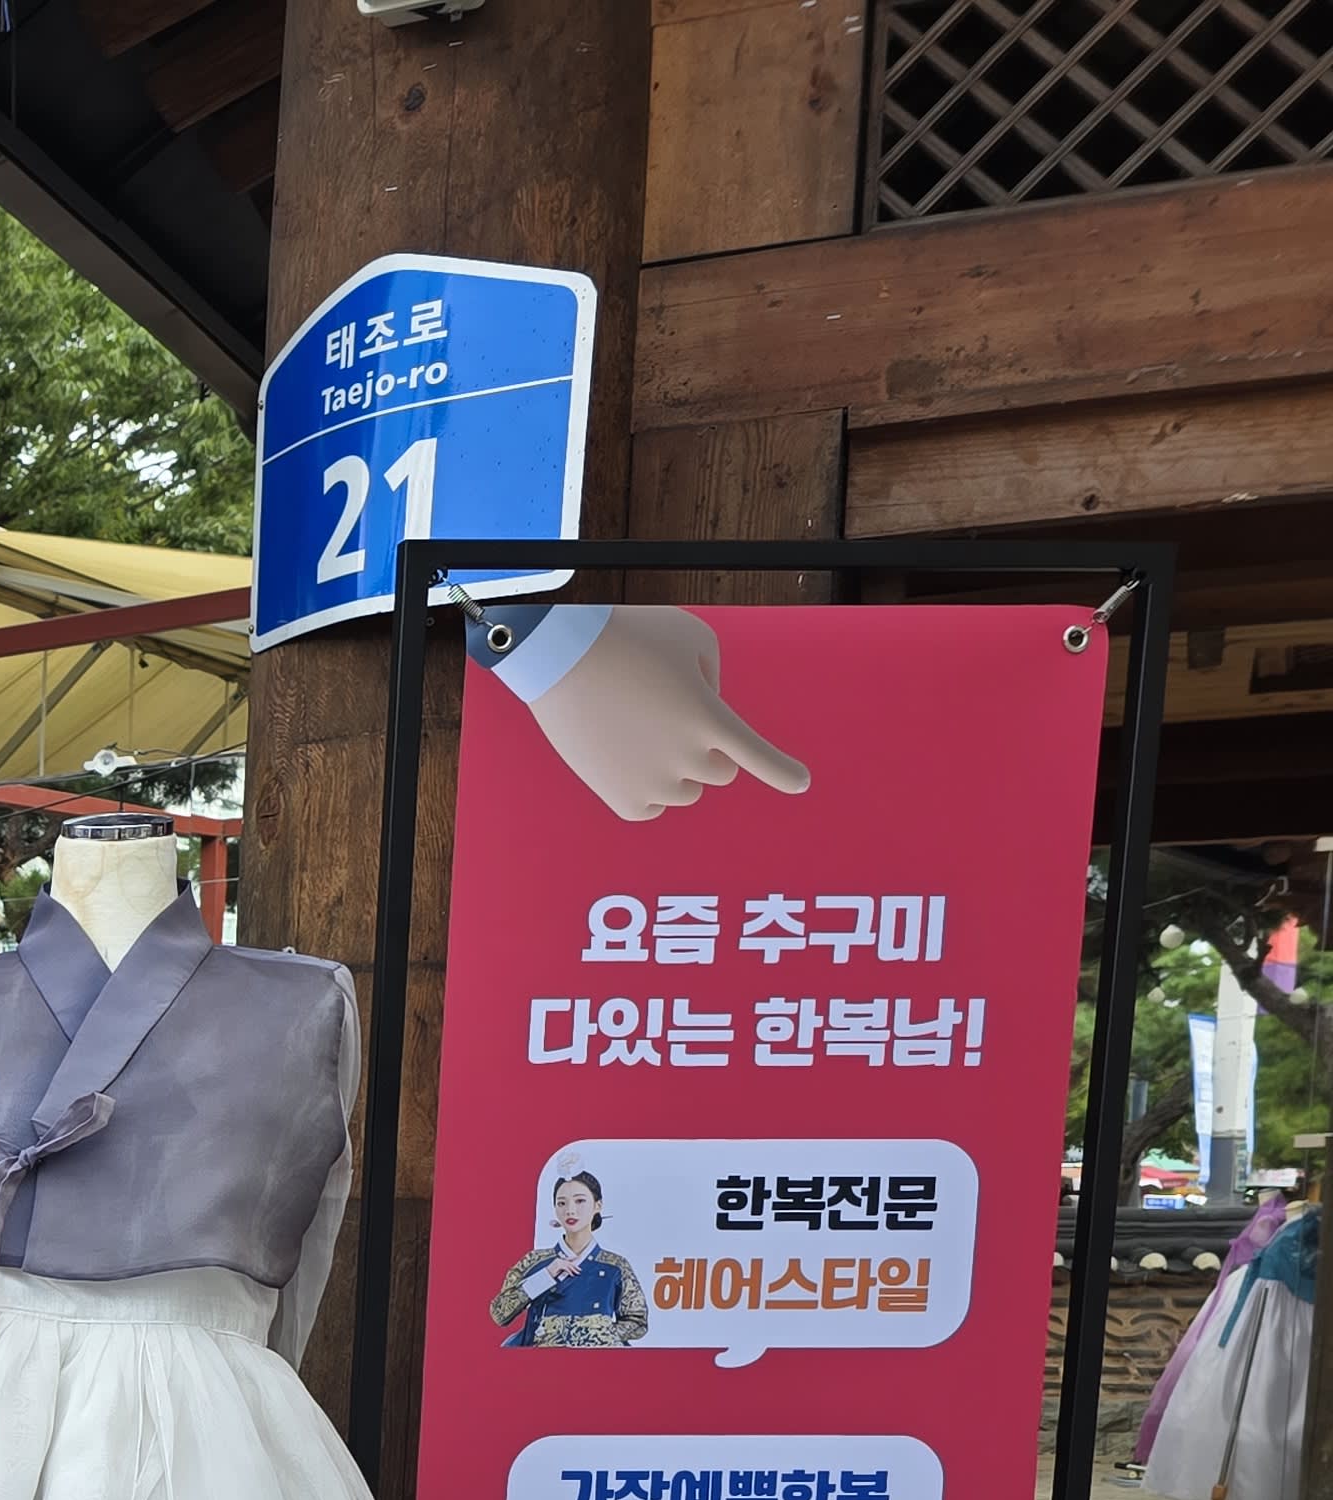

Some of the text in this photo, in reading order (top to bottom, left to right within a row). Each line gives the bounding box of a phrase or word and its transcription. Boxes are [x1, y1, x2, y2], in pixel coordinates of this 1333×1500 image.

[324, 299, 449, 370] 태조로
[321, 358, 449, 417] Taejo-ro
[316, 437, 439, 585] 21
[582, 893, 946, 965] 요즘 추구미
[527, 997, 986, 1067] 다있는 한복남!
[715, 1174, 939, 1232] 한복전문
[653, 1256, 931, 1313] 헤어스타일
